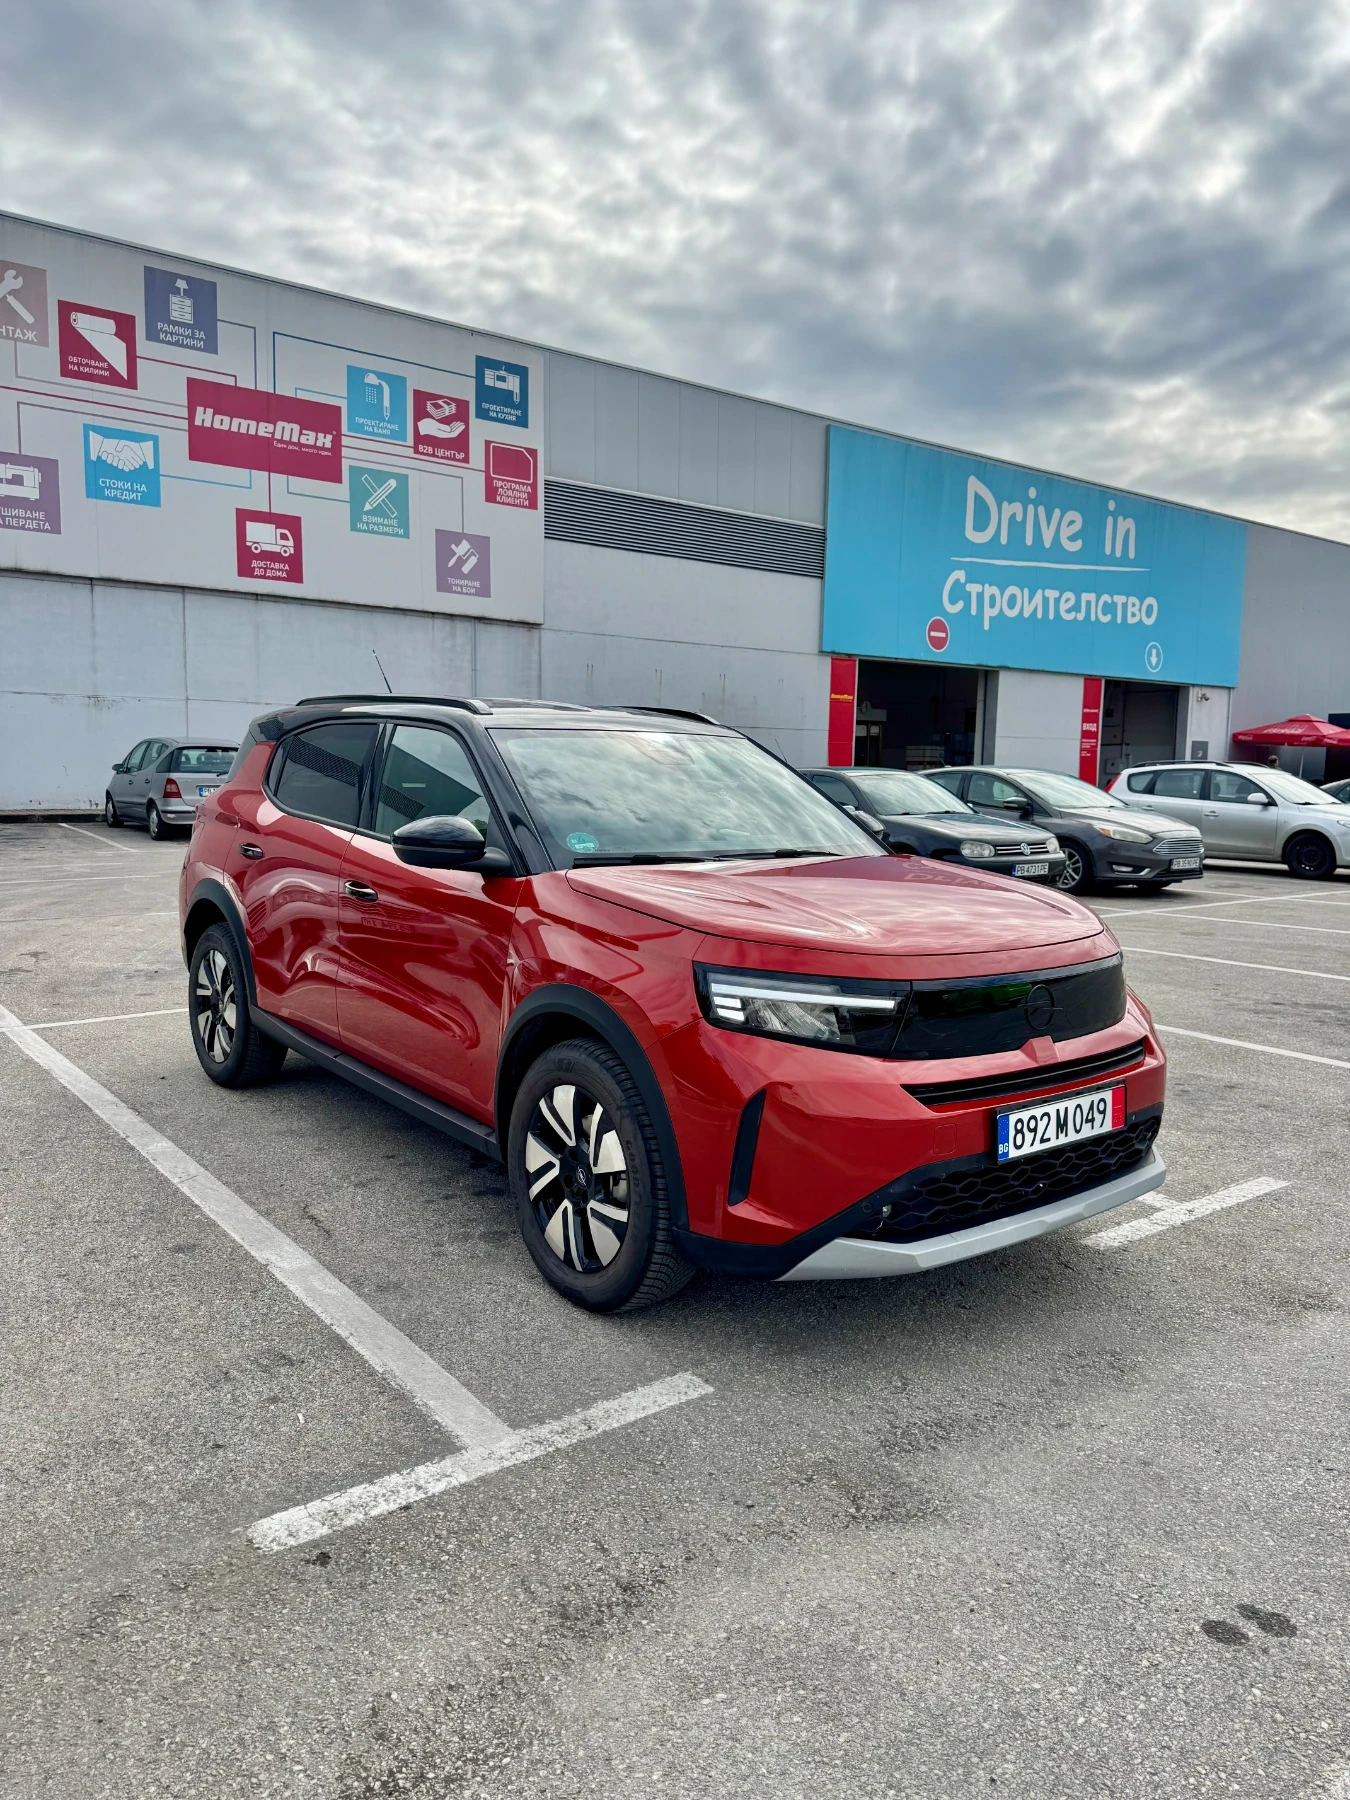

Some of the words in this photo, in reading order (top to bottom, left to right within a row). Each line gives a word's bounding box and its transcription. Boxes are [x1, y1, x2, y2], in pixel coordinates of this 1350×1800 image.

[157, 322, 192, 337] РАМКИ
[194, 329, 206, 340] ЗА
[160, 332, 204, 349] КАРТИНИ
[68, 355, 109, 369] ОБТОЧВАНЕ
[68, 364, 79, 372] НА
[80, 365, 110, 377] КИЛИМИ
[481, 402, 522, 416] ПРОЕКТИРАНЕ
[489, 410, 498, 418] НА
[498, 412, 517, 421] КУХНЯ
[194, 405, 333, 448] HomeMax
[355, 416, 400, 431] ПРОЕКТИРАНЕ
[374, 426, 391, 436] БАНЯ
[434, 447, 465, 460] ЦЕНТЪР
[99, 478, 131, 490] СТОКИ
[133, 482, 148, 493] НА
[493, 480, 532, 493] ПРОГРАМА
[104, 488, 143, 501] КРЕДИТ
[497, 488, 528, 500] ЛОЯЛНИ
[496, 495, 529, 507] КЛИЕНТИ
[0, 506, 46, 520] ШИВАНЕ
[965, 475, 1082, 552] Drive
[1105, 499, 1136, 560] in
[5, 517, 51, 530] ПЕРДЕТА
[362, 514, 399, 527] ВЗИМАНЕ
[357, 522, 368, 531] НА
[369, 523, 404, 535] РАЗМЕРИ
[251, 560, 290, 571] ДОСТАВКА
[254, 568, 265, 576] ДО
[266, 570, 287, 578] ДОМА
[447, 577, 480, 588] ТОНИРАНЕ
[452, 585, 462, 593] НА
[462, 586, 476, 594] БОИ
[942, 569, 1158, 631] Строителство
[998, 1142, 1009, 1155] BG
